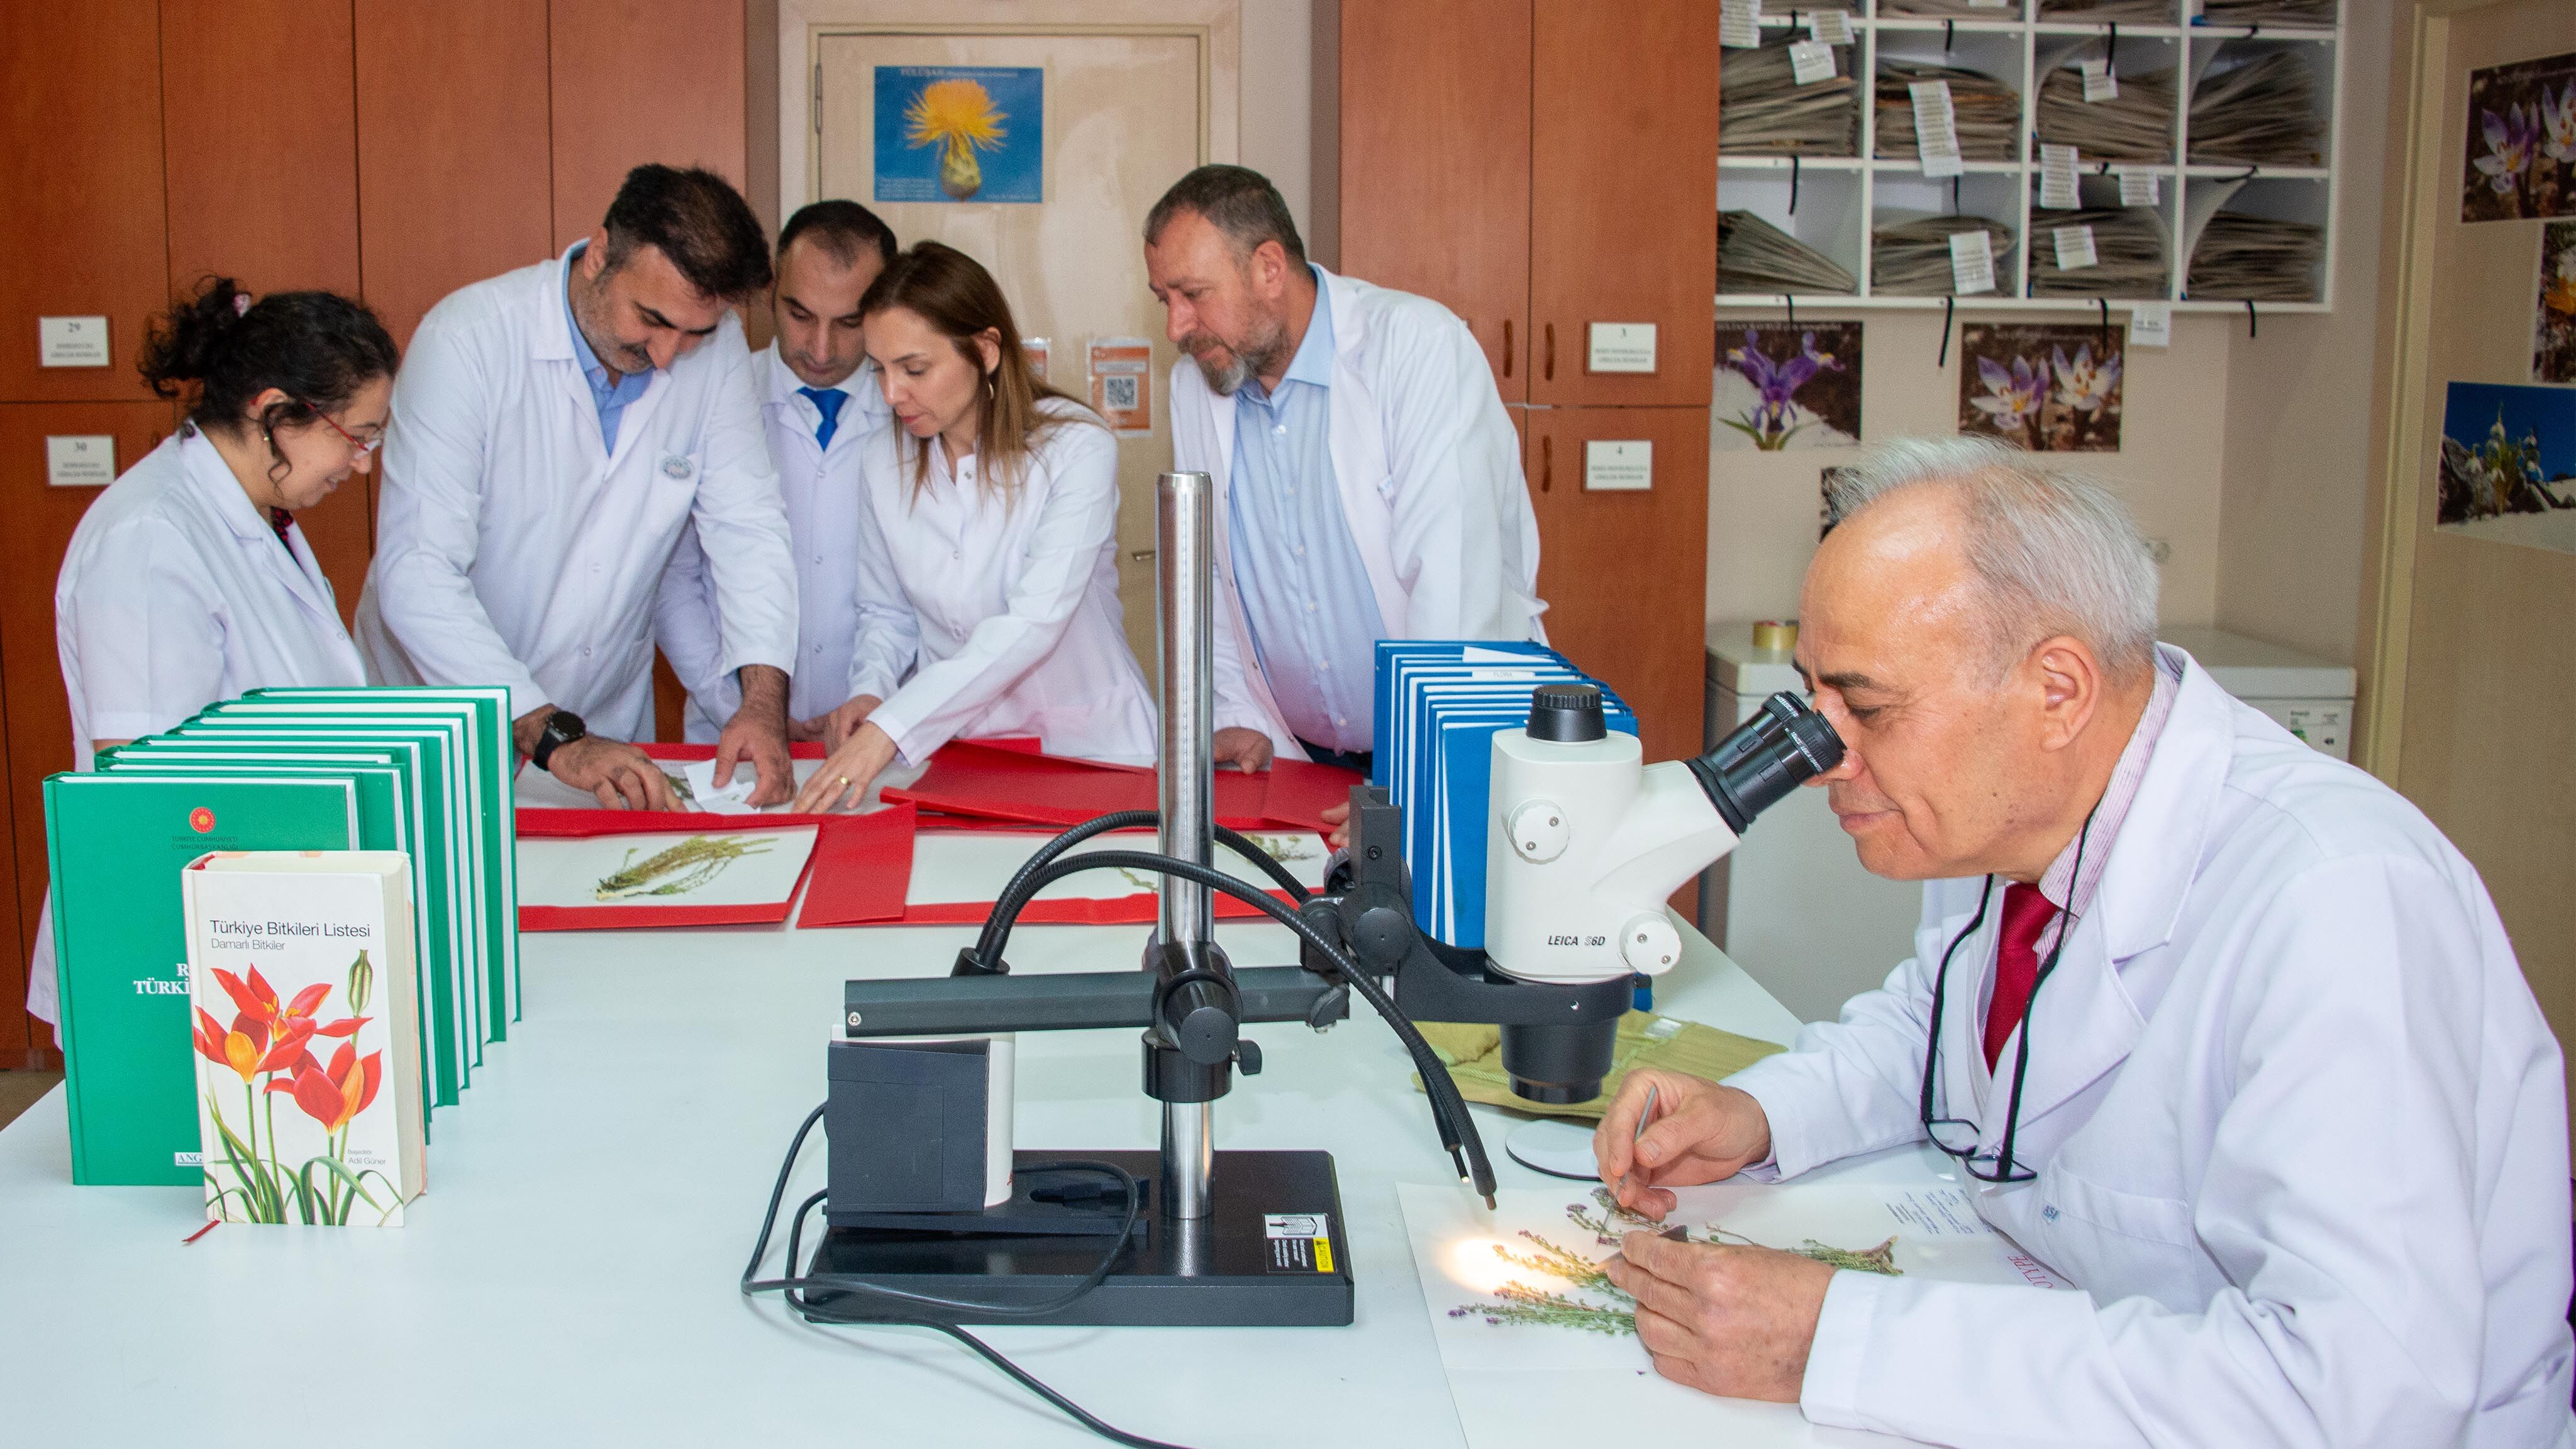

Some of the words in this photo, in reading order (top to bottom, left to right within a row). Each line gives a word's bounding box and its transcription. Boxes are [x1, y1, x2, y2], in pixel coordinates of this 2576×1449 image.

[209, 919, 263, 937] Türkiye
[267, 921, 319, 936] Bitkileri
[325, 923, 371, 937] Listesi
[211, 938, 249, 950] Damarlı
[252, 940, 286, 950] Bitkiler
[1548, 935, 1579, 946] LEICA
[1584, 935, 1606, 946] S6D
